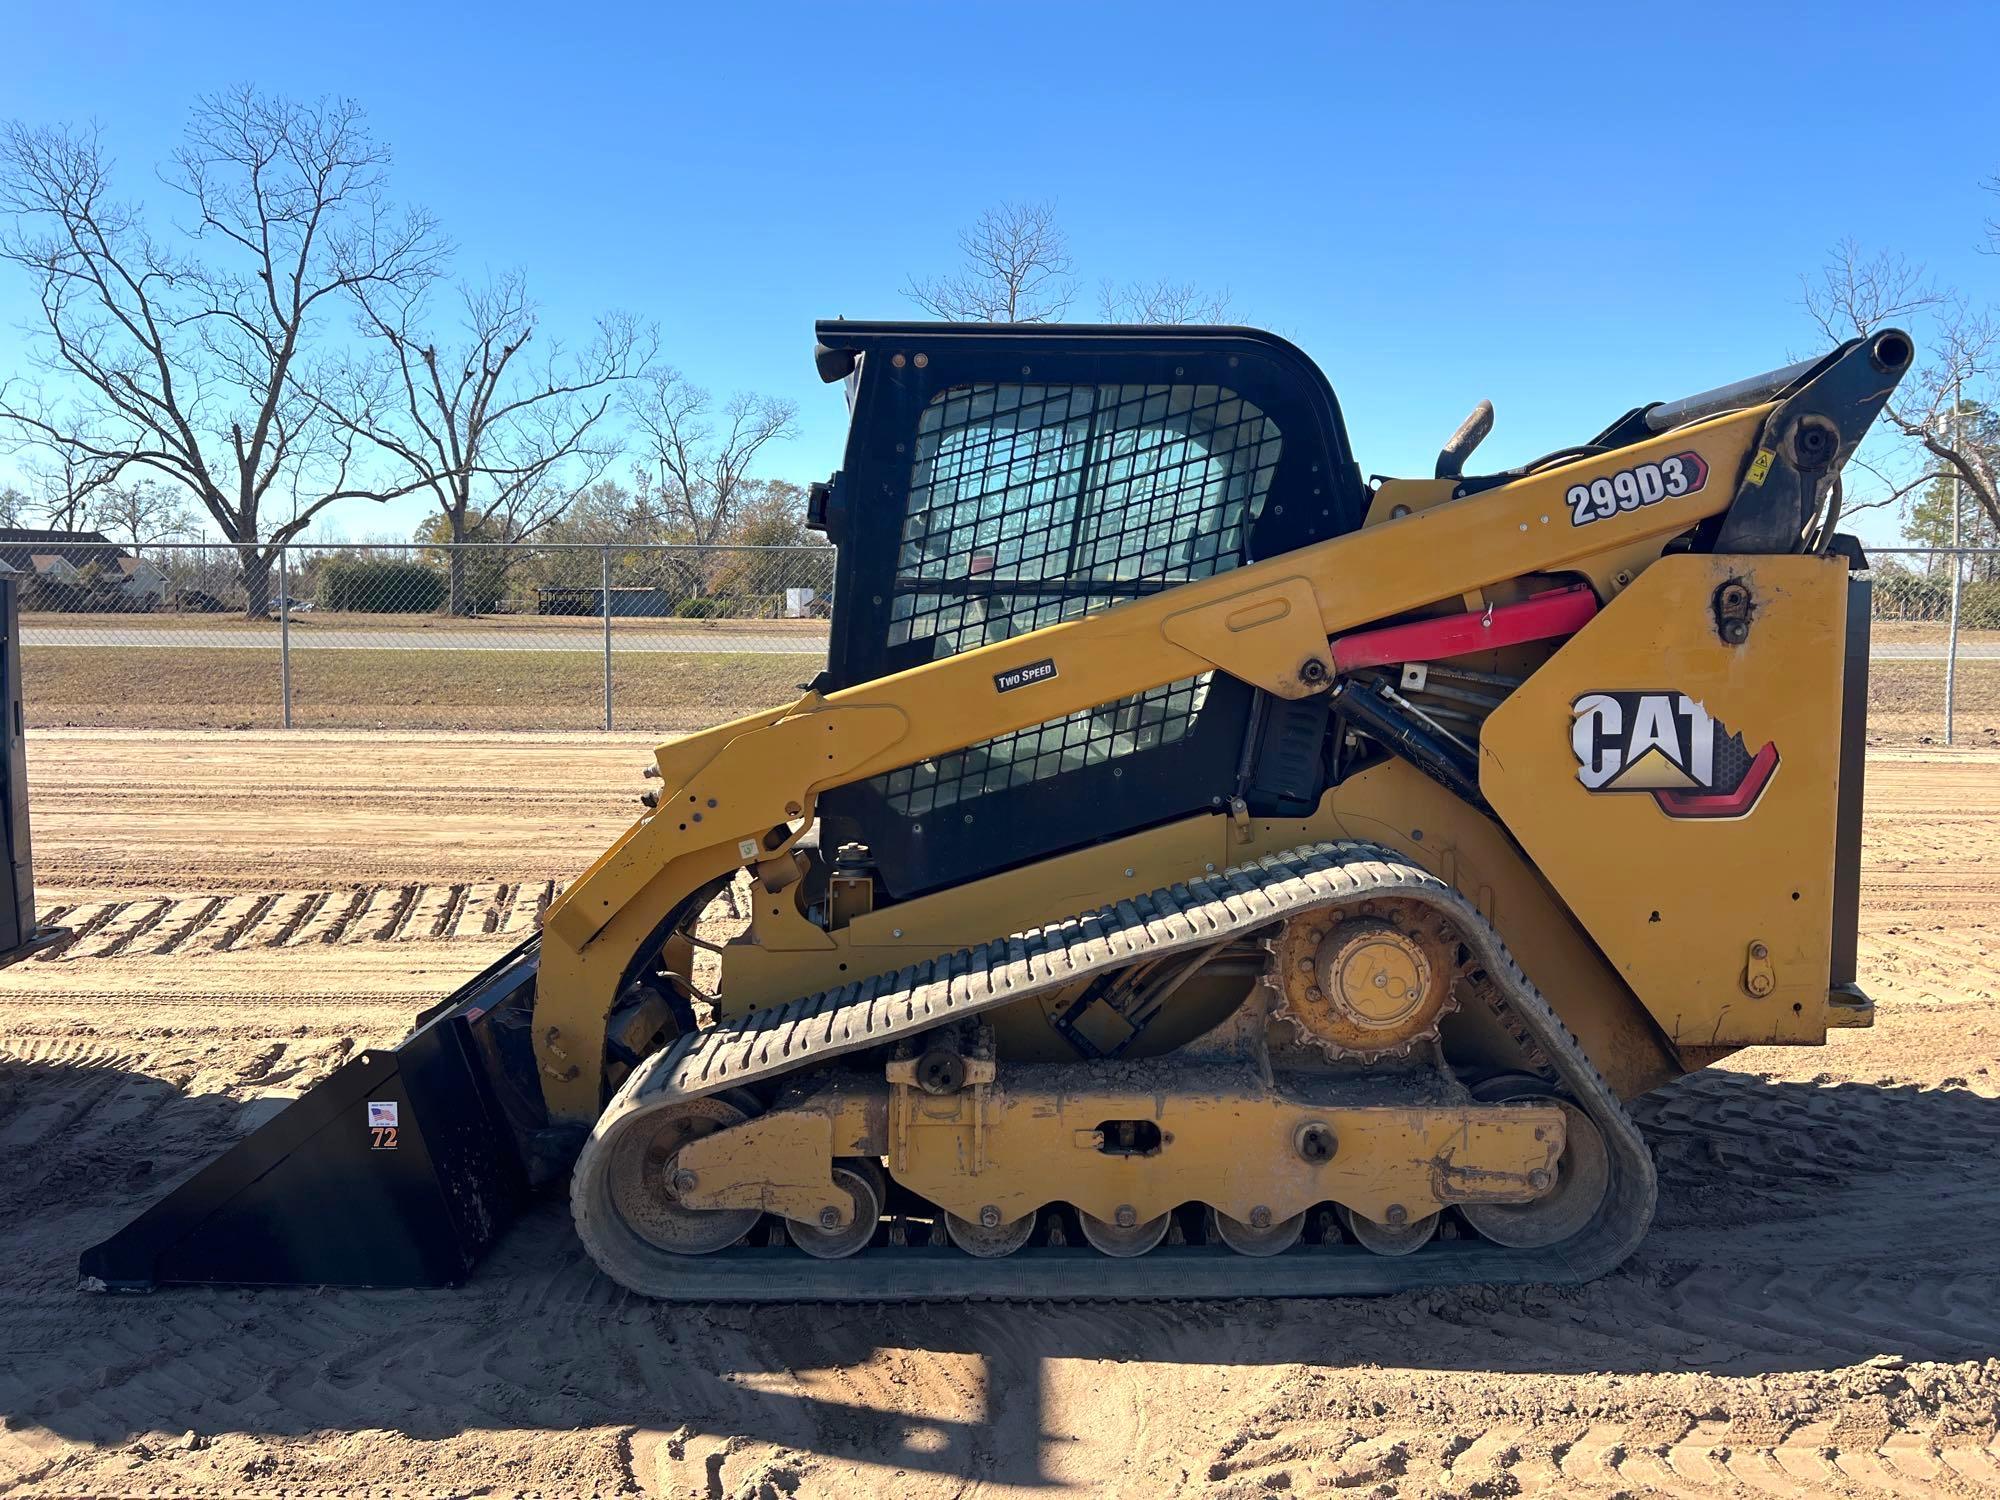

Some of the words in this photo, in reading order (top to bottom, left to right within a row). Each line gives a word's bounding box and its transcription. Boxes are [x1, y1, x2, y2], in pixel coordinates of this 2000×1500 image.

[1567, 458, 1688, 525] 299D3
[999, 675, 1020, 688] TWO
[1022, 665, 1051, 681] SPEED
[1573, 695, 1714, 788] CAT
[371, 1127, 398, 1147] 72
